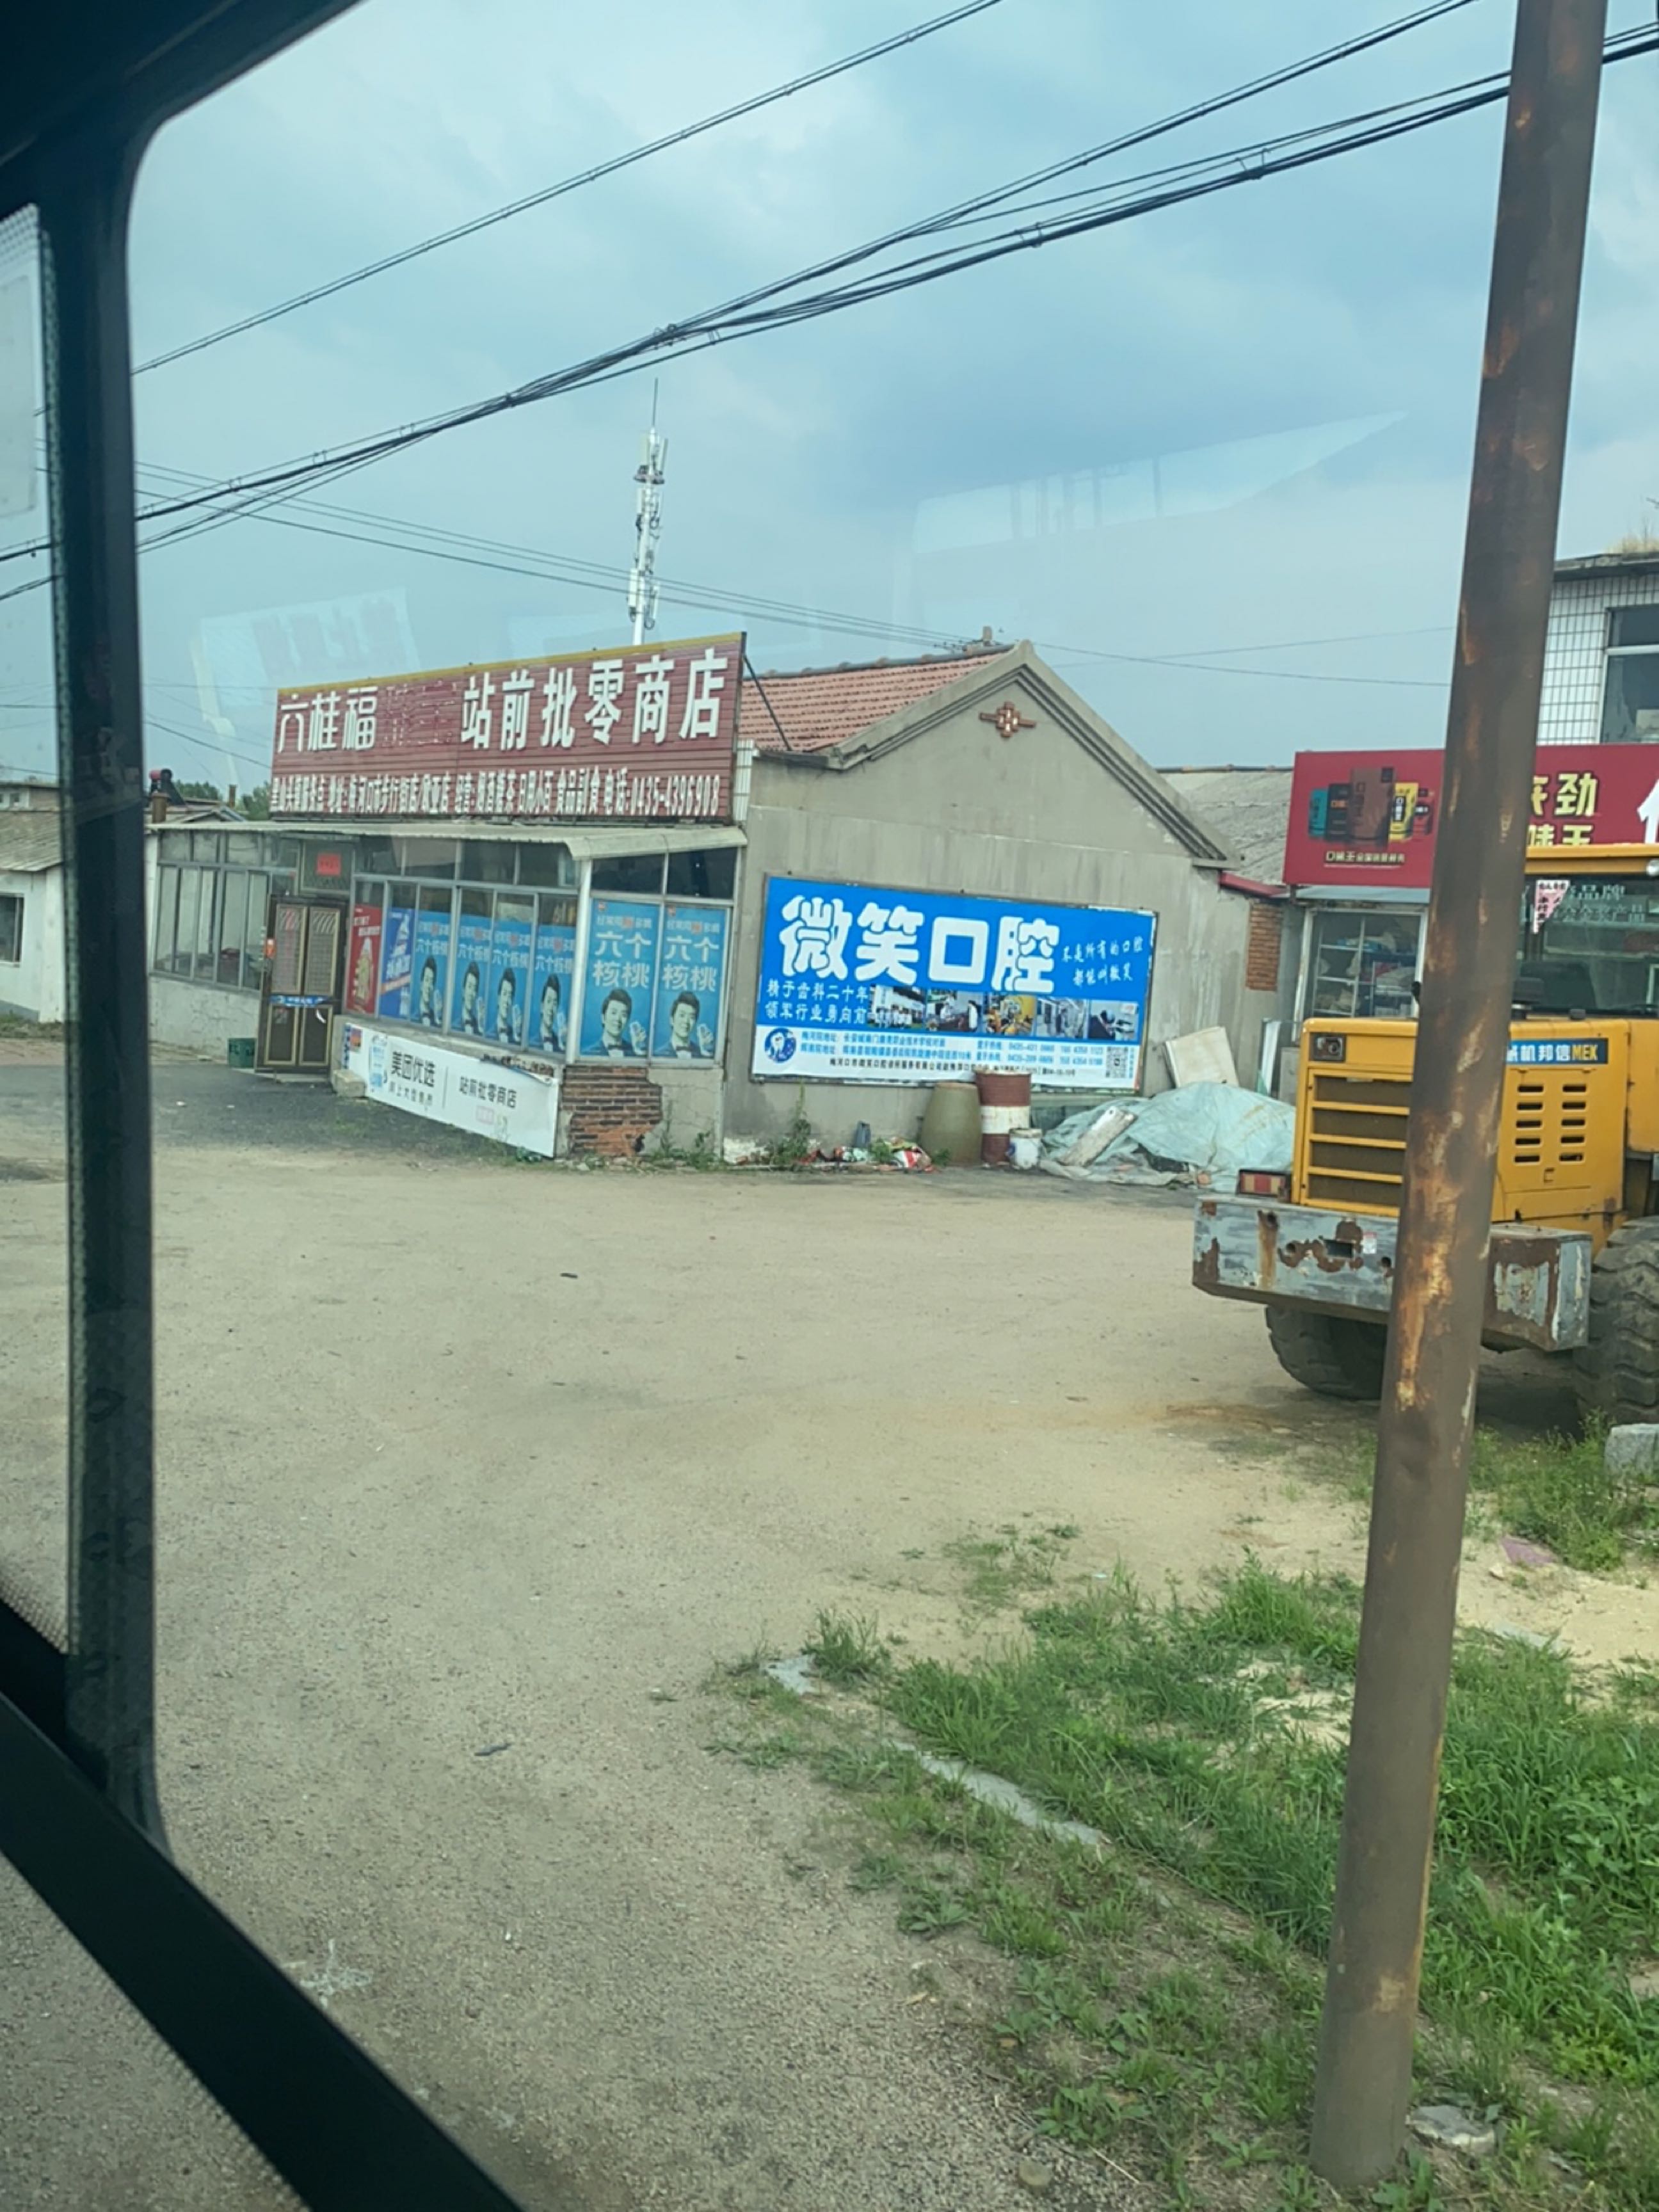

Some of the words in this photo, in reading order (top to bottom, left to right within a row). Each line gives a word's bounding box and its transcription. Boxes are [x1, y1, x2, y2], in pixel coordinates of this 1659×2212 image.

[277, 685, 378, 753] 六桂福
[461, 648, 728, 751] 站前批零商店
[595, 931, 652, 959] 六个
[664, 935, 719, 963] 六个
[779, 894, 1059, 994] 微笑口腔
[593, 959, 650, 988] 核桃
[662, 963, 717, 991] 核桃
[390, 1051, 436, 1088] 美团优选
